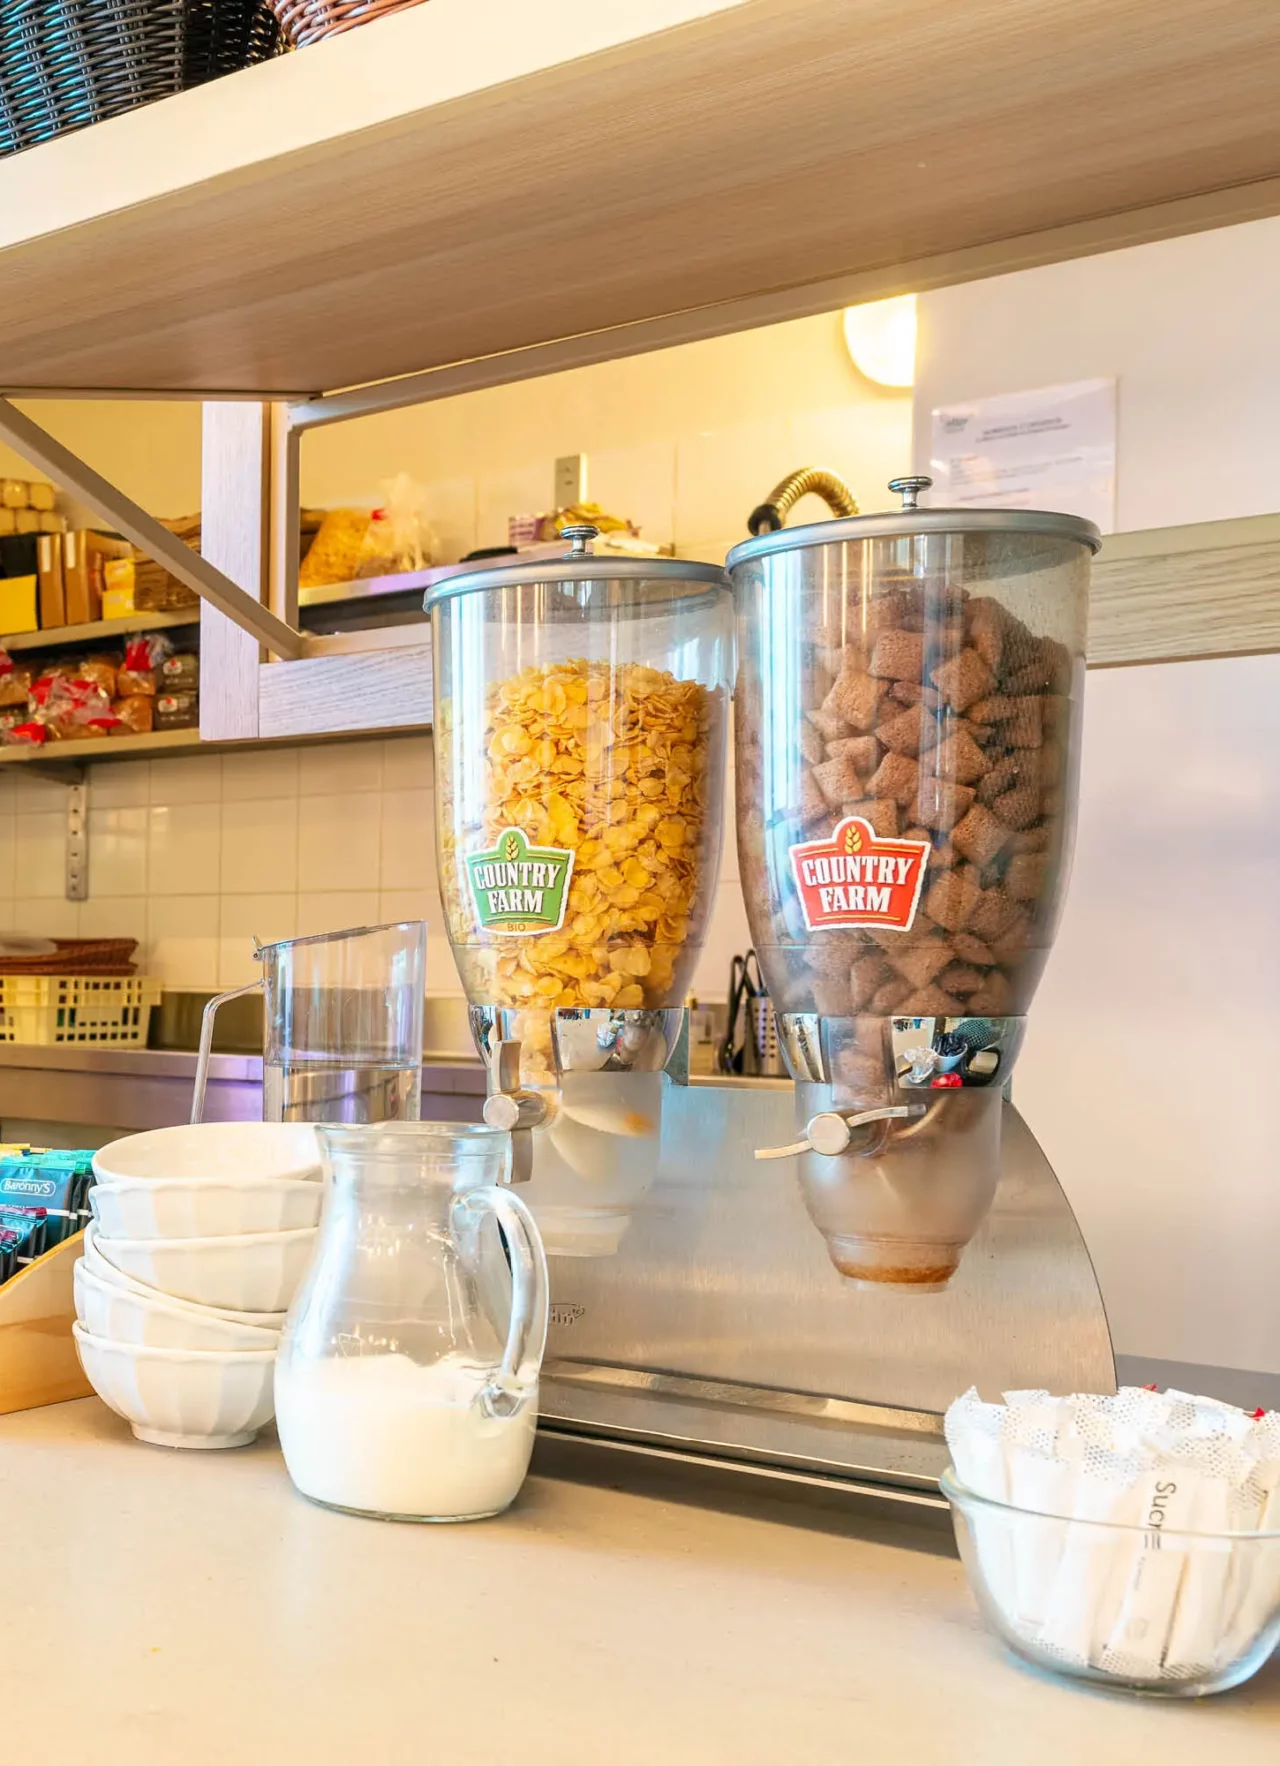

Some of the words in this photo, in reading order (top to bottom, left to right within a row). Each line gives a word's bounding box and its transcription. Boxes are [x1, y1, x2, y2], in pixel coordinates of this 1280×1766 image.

[473, 862, 561, 890] COUNTRY
[801, 855, 915, 887] COUNTRY
[487, 889, 544, 914] FARM
[818, 885, 892, 913] FARM
[507, 923, 526, 932] BIO
